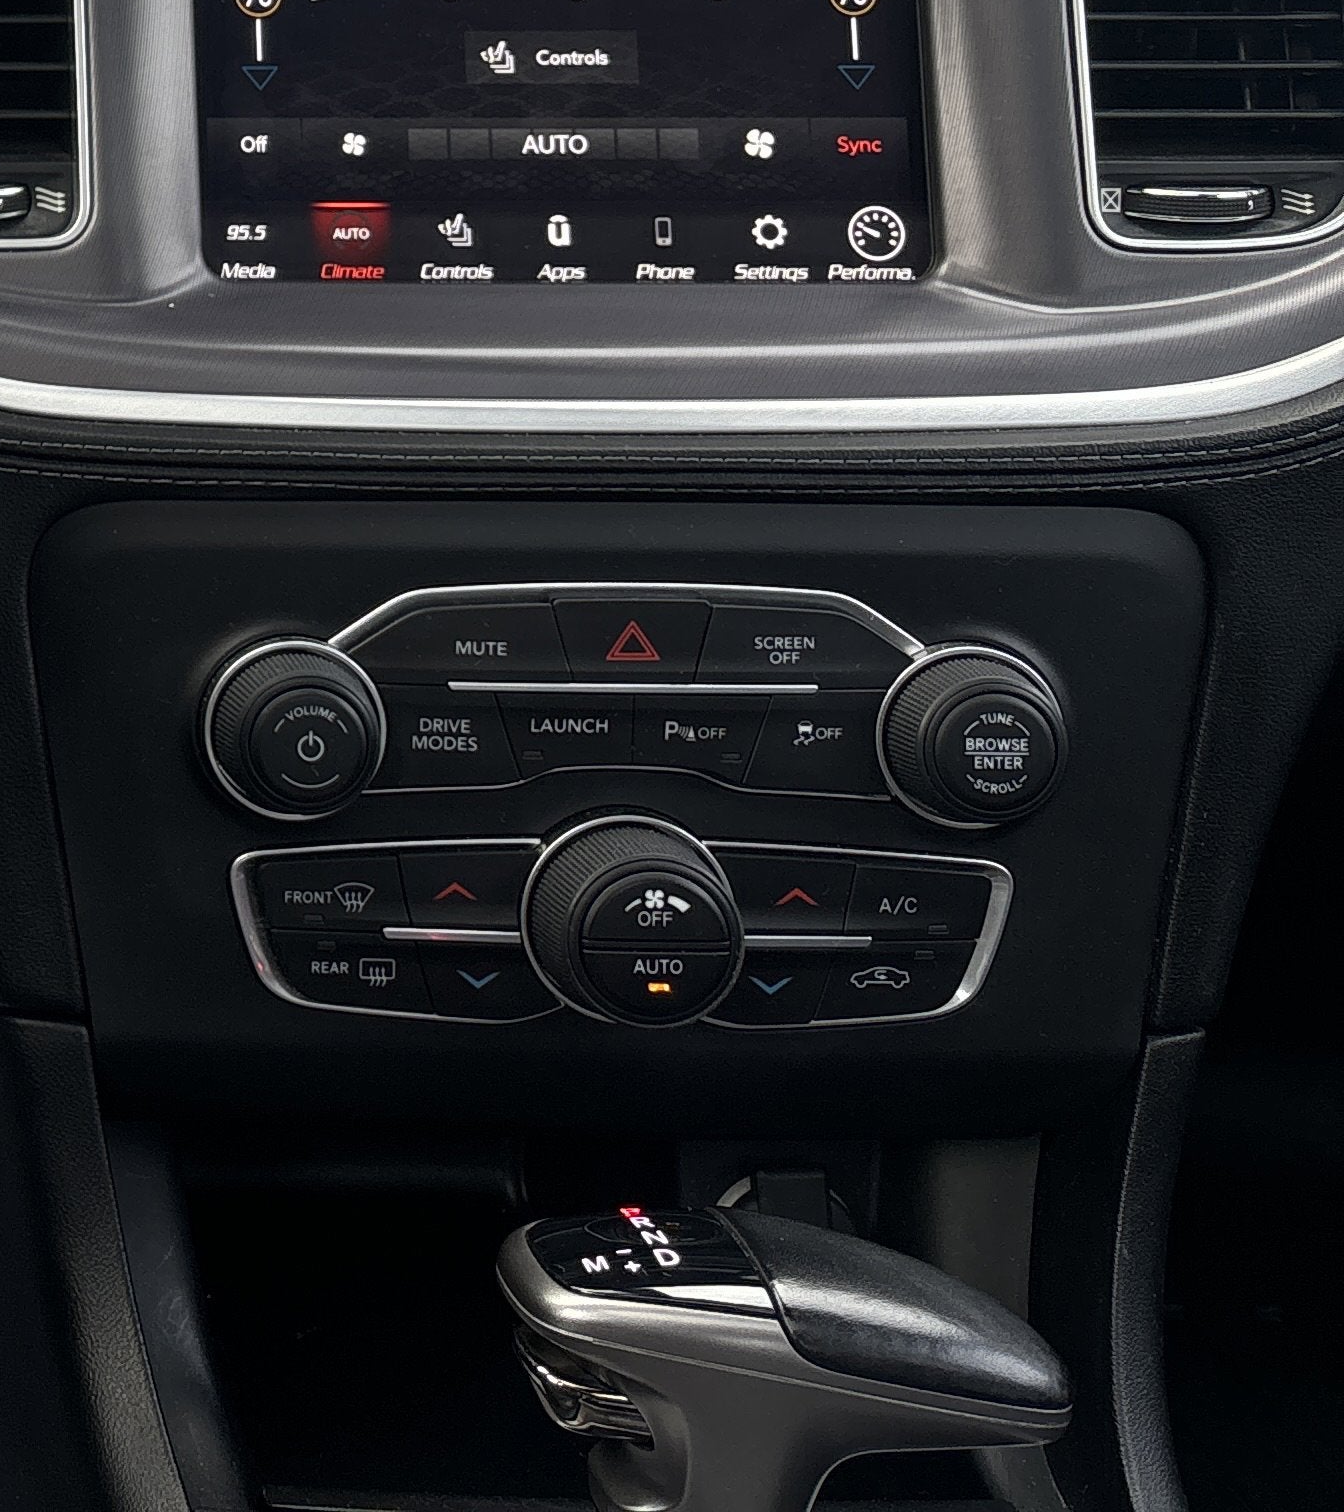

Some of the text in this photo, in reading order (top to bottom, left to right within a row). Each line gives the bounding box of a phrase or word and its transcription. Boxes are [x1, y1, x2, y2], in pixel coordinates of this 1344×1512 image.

[535, 48, 609, 67] Controls
[240, 135, 269, 153] Off
[521, 133, 589, 155] AUTO
[837, 136, 883, 157] Sync
[226, 224, 268, 241] 95.5
[332, 227, 371, 240] AUTO
[220, 262, 276, 280] Media
[320, 263, 386, 280] Climate
[420, 263, 495, 280] Controls
[537, 263, 587, 282] Apps
[635, 263, 695, 281] Phone
[734, 263, 810, 281] Settings
[454, 640, 509, 657] MUTE
[753, 635, 816, 650] SCREEN
[769, 651, 801, 666] OFF
[284, 704, 339, 723] VOLUME
[978, 712, 1017, 727] TUNE
[419, 717, 472, 734] DRIVE
[530, 718, 610, 735] LAUNCH
[697, 725, 727, 741] OFF
[815, 726, 844, 741] OFF
[411, 735, 479, 753] MODES
[965, 736, 1030, 752] BROWSE
[973, 755, 1024, 771] ENTER
[972, 777, 1023, 795] SCROLL
[283, 890, 334, 906] FRONT
[878, 896, 918, 915] A/C
[637, 911, 674, 928] OFF
[310, 960, 349, 975] REAR
[632, 959, 684, 976] AUTO
[629, 1216, 656, 1229] R
[640, 1229, 669, 1246] N
[581, 1255, 610, 1273] M
[653, 1248, 681, 1267] D
